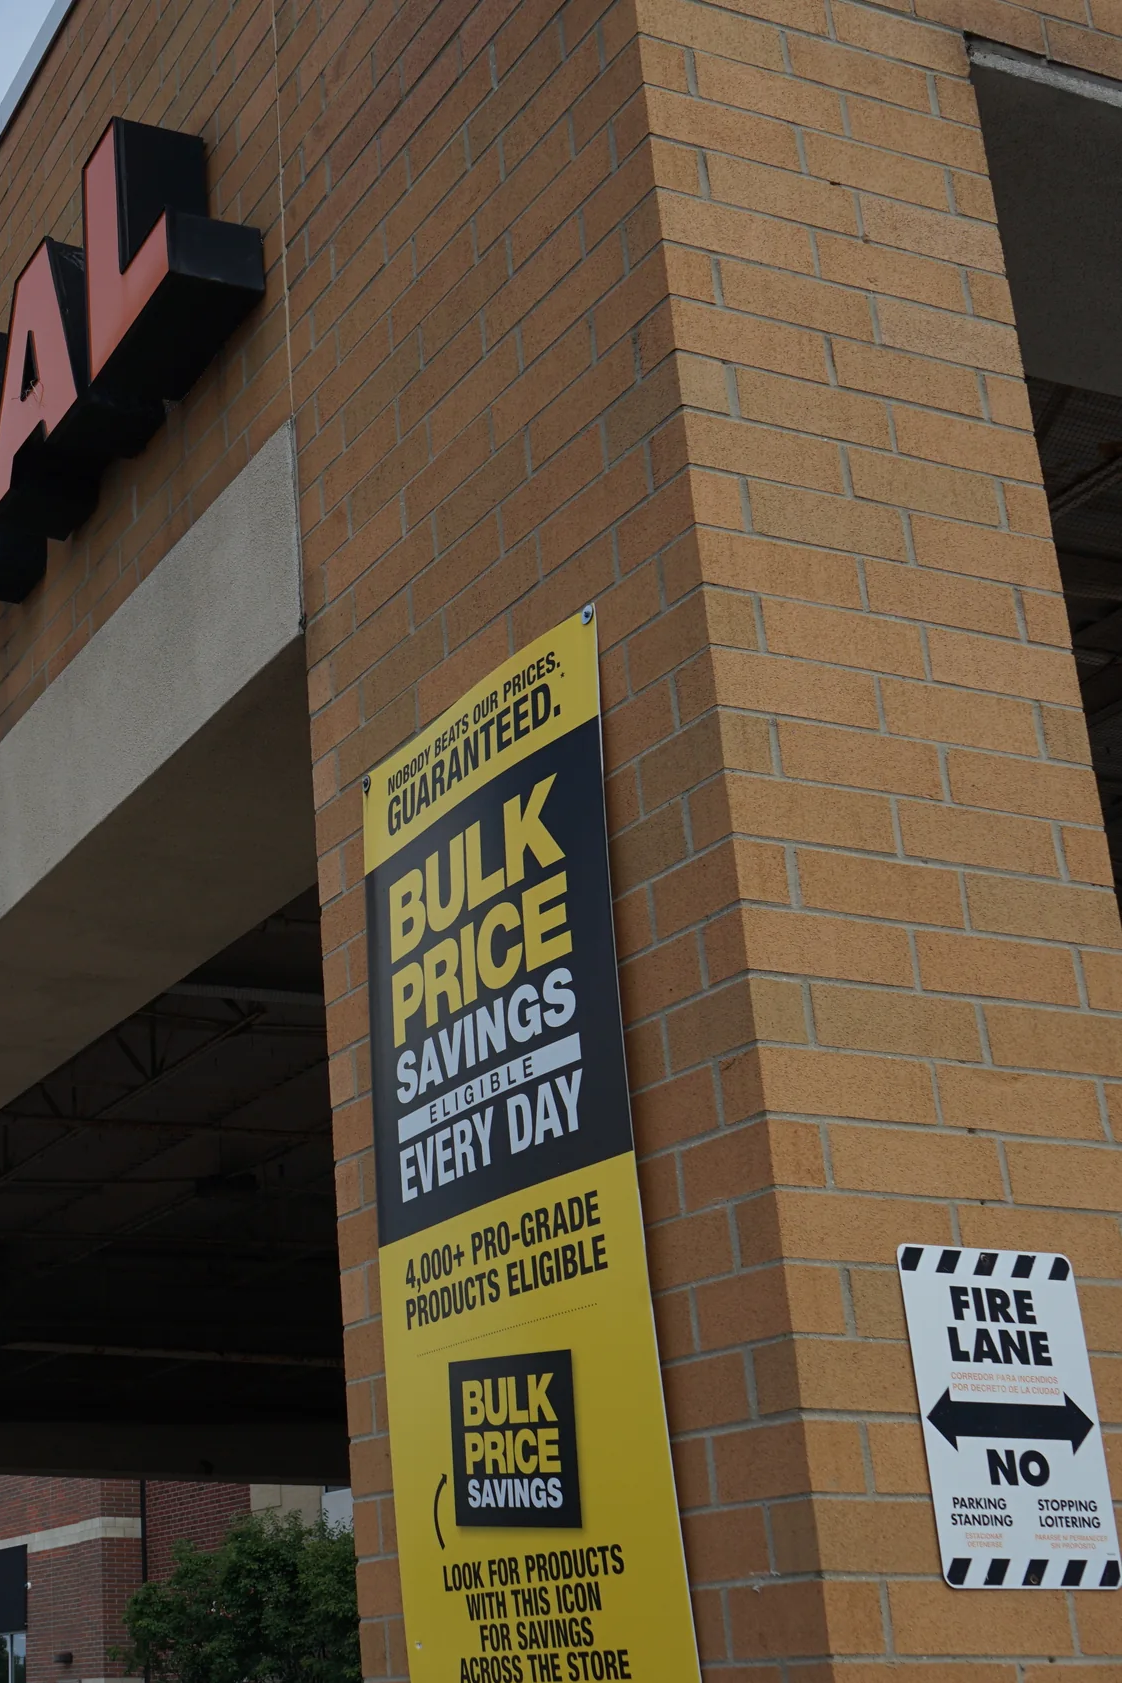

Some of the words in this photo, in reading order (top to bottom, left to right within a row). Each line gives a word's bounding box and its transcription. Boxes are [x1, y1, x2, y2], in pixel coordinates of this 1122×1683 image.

[387, 745, 431, 796] NOBODY
[434, 712, 469, 758] BEATS
[473, 690, 499, 725] OUR
[503, 651, 561, 703] PRICES.
[389, 772, 566, 964] BULK
[392, 870, 573, 1048] PRICE
[396, 967, 576, 1104] SAVINGS
[429, 1056, 534, 1124] ELIGIBLE
[399, 1106, 494, 1203] EVERY
[507, 1068, 583, 1155] DAY
[405, 1243, 465, 1293] 4,000+
[471, 1190, 601, 1265] PRO-GRADE
[405, 1268, 501, 1330] PRODUCTS
[506, 1234, 609, 1297] ELIGIBLE
[949, 1285, 1037, 1325] FIRE
[946, 1326, 1053, 1366] LANE
[950, 1371, 995, 1381] CORREDOR
[996, 1373, 1017, 1382] PARA
[1018, 1375, 1058, 1384] INCENDIOS
[952, 1383, 969, 1391] POR
[971, 1384, 1007, 1393] DECRETO
[1032, 1387, 1060, 1395] CIUDAD
[462, 1372, 558, 1427] BULK
[464, 1427, 562, 1475] PRICE
[986, 1448, 1050, 1487] NO
[468, 1477, 564, 1509] SAVINGS
[952, 1496, 1007, 1511] PARKING
[1037, 1499, 1098, 1512] STOPPING
[951, 1513, 1013, 1527] STANDING
[1039, 1515, 1101, 1529] LOITERING
[442, 1561, 485, 1592] LOOK
[488, 1557, 520, 1587] FOR
[524, 1544, 625, 1583] PRODUCTS
[465, 1591, 508, 1621] WITH
[511, 1586, 551, 1617] THIS
[555, 1581, 602, 1614] ICON
[479, 1622, 512, 1652] FOR
[516, 1616, 594, 1651] SAVINGS
[460, 1654, 523, 1683] ACROSS
[527, 1653, 562, 1683] THE
[566, 1649, 632, 1682] STORE
